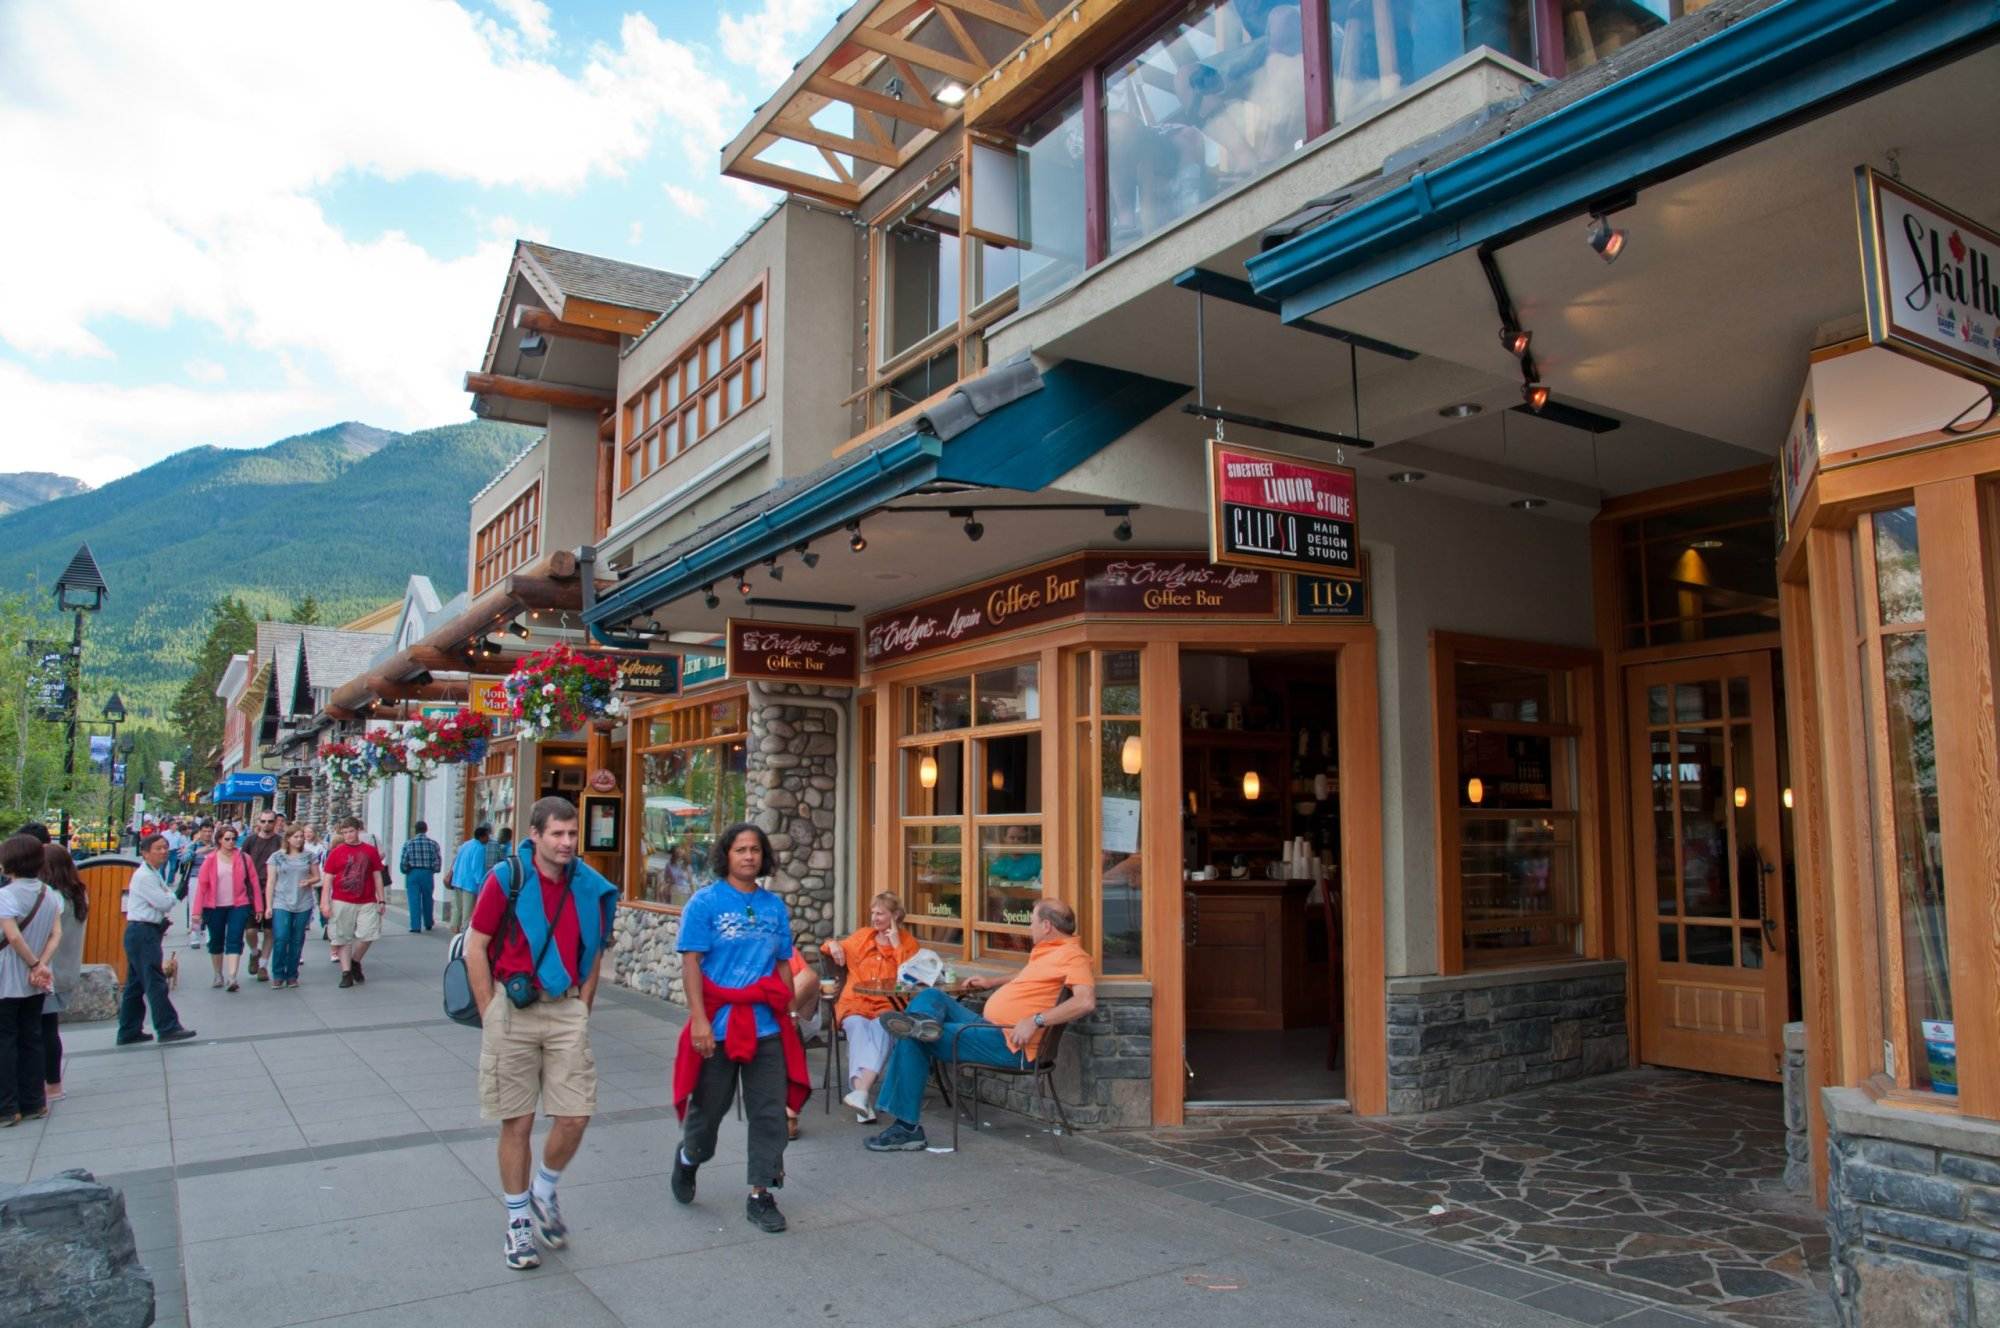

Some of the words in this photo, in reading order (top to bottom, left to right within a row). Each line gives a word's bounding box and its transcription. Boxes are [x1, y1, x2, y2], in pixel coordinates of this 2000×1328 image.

[1227, 462, 1274, 478] SIDESTREET
[1264, 477, 1315, 506] LIQUOR
[1316, 491, 1350, 517] STORE
[1234, 507, 1298, 553] CLIPSO
[1314, 522, 1340, 535] HAIR
[1307, 534, 1348, 549] DESIGN
[1308, 547, 1348, 561] STUDIO
[1223, 567, 1260, 589] Again
[1143, 588, 1191, 610] Coffee
[1196, 589, 1223, 607] Bar
[1309, 582, 1352, 607] 119
[947, 607, 981, 639] Again
[986, 583, 1041, 626] Coffee
[1046, 575, 1080, 604] Bar
[767, 655, 801, 671] Coffee
[805, 657, 825, 671] Bar
[630, 678, 660, 687] MINE
[927, 902, 952, 918] Healthy
